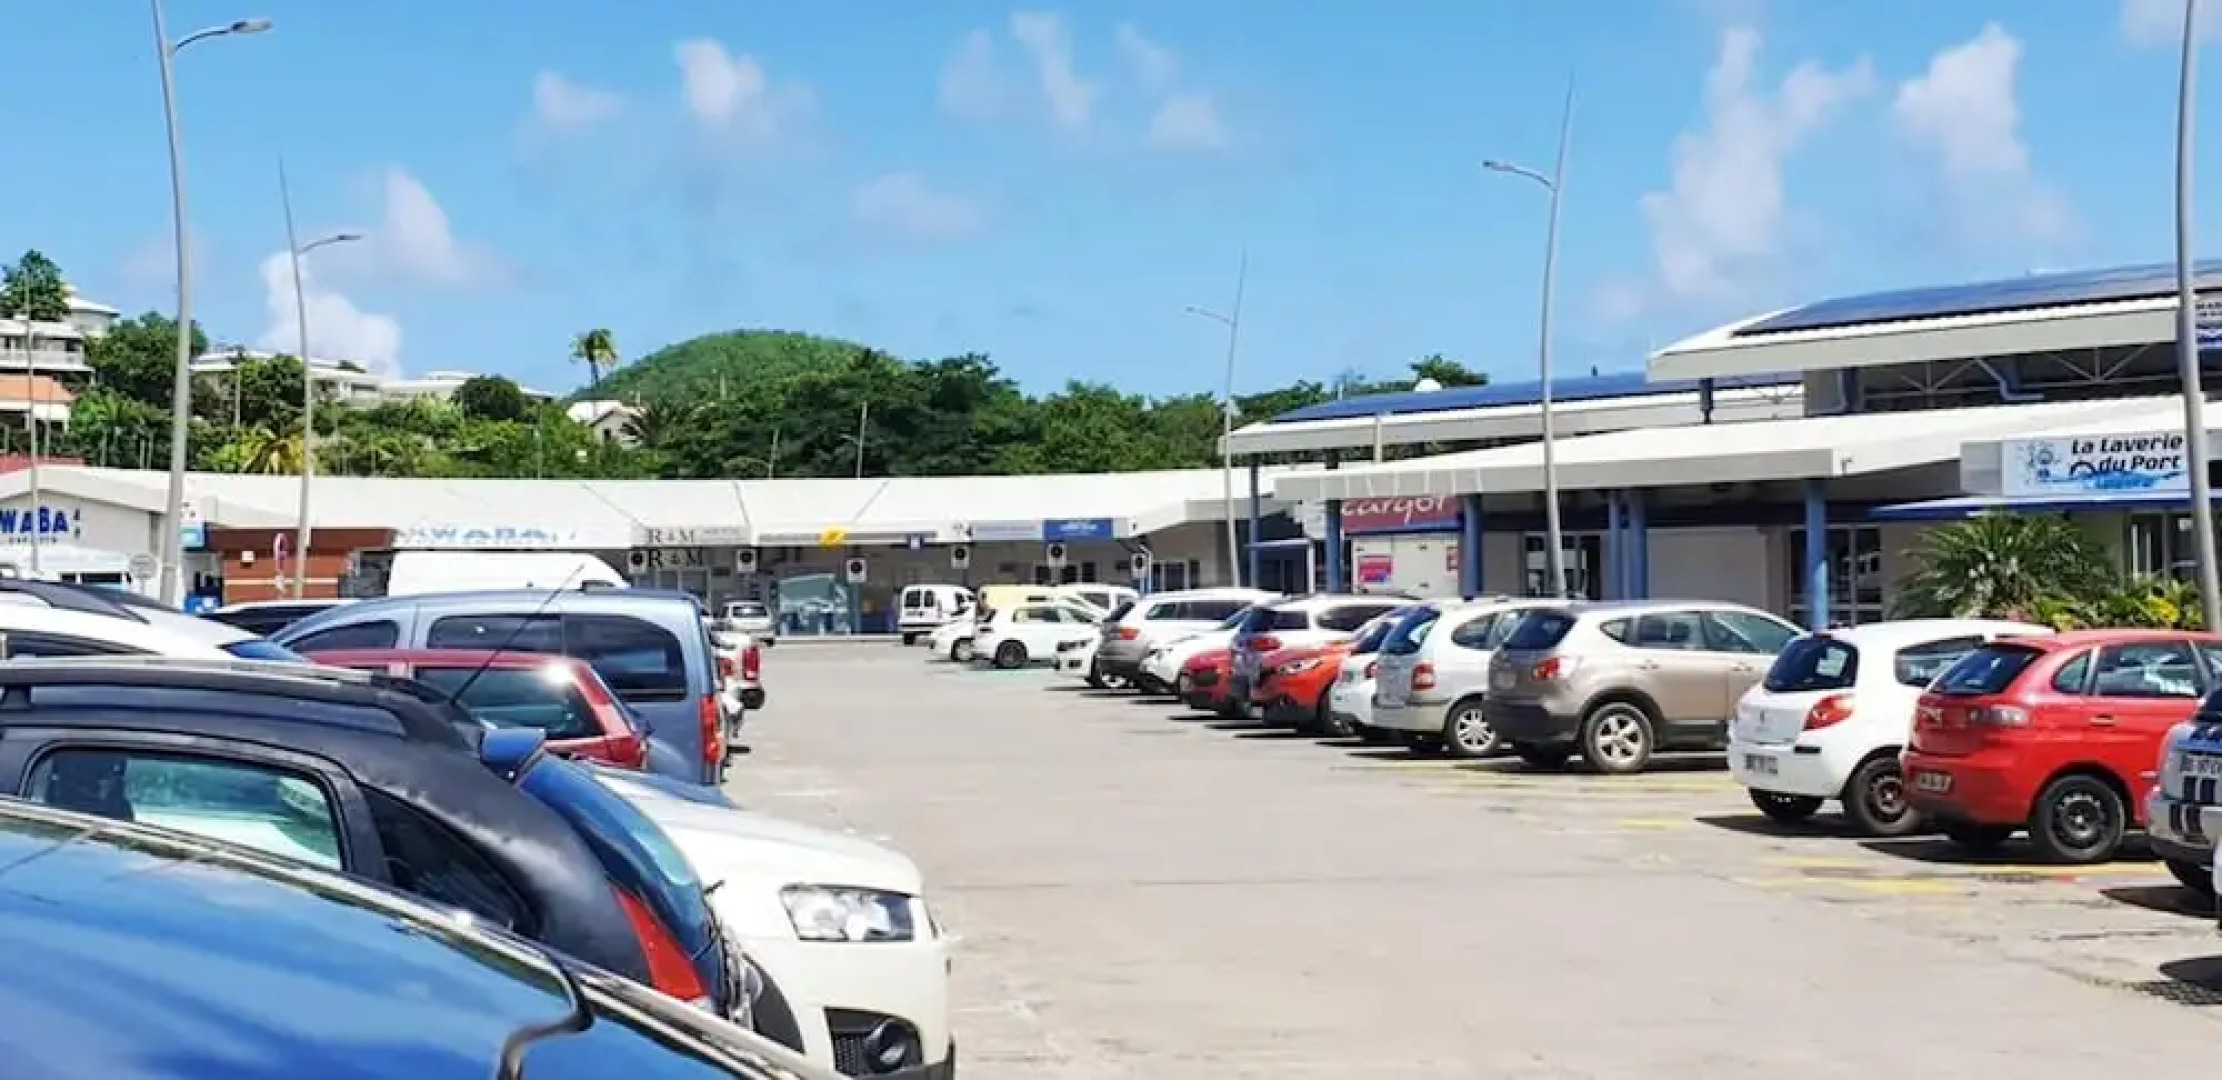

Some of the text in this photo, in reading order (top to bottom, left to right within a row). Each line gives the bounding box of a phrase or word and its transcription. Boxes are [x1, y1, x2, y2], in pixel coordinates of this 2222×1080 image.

[2073, 434, 2183, 455] La Laverie
[2099, 455, 2180, 471] du Port
